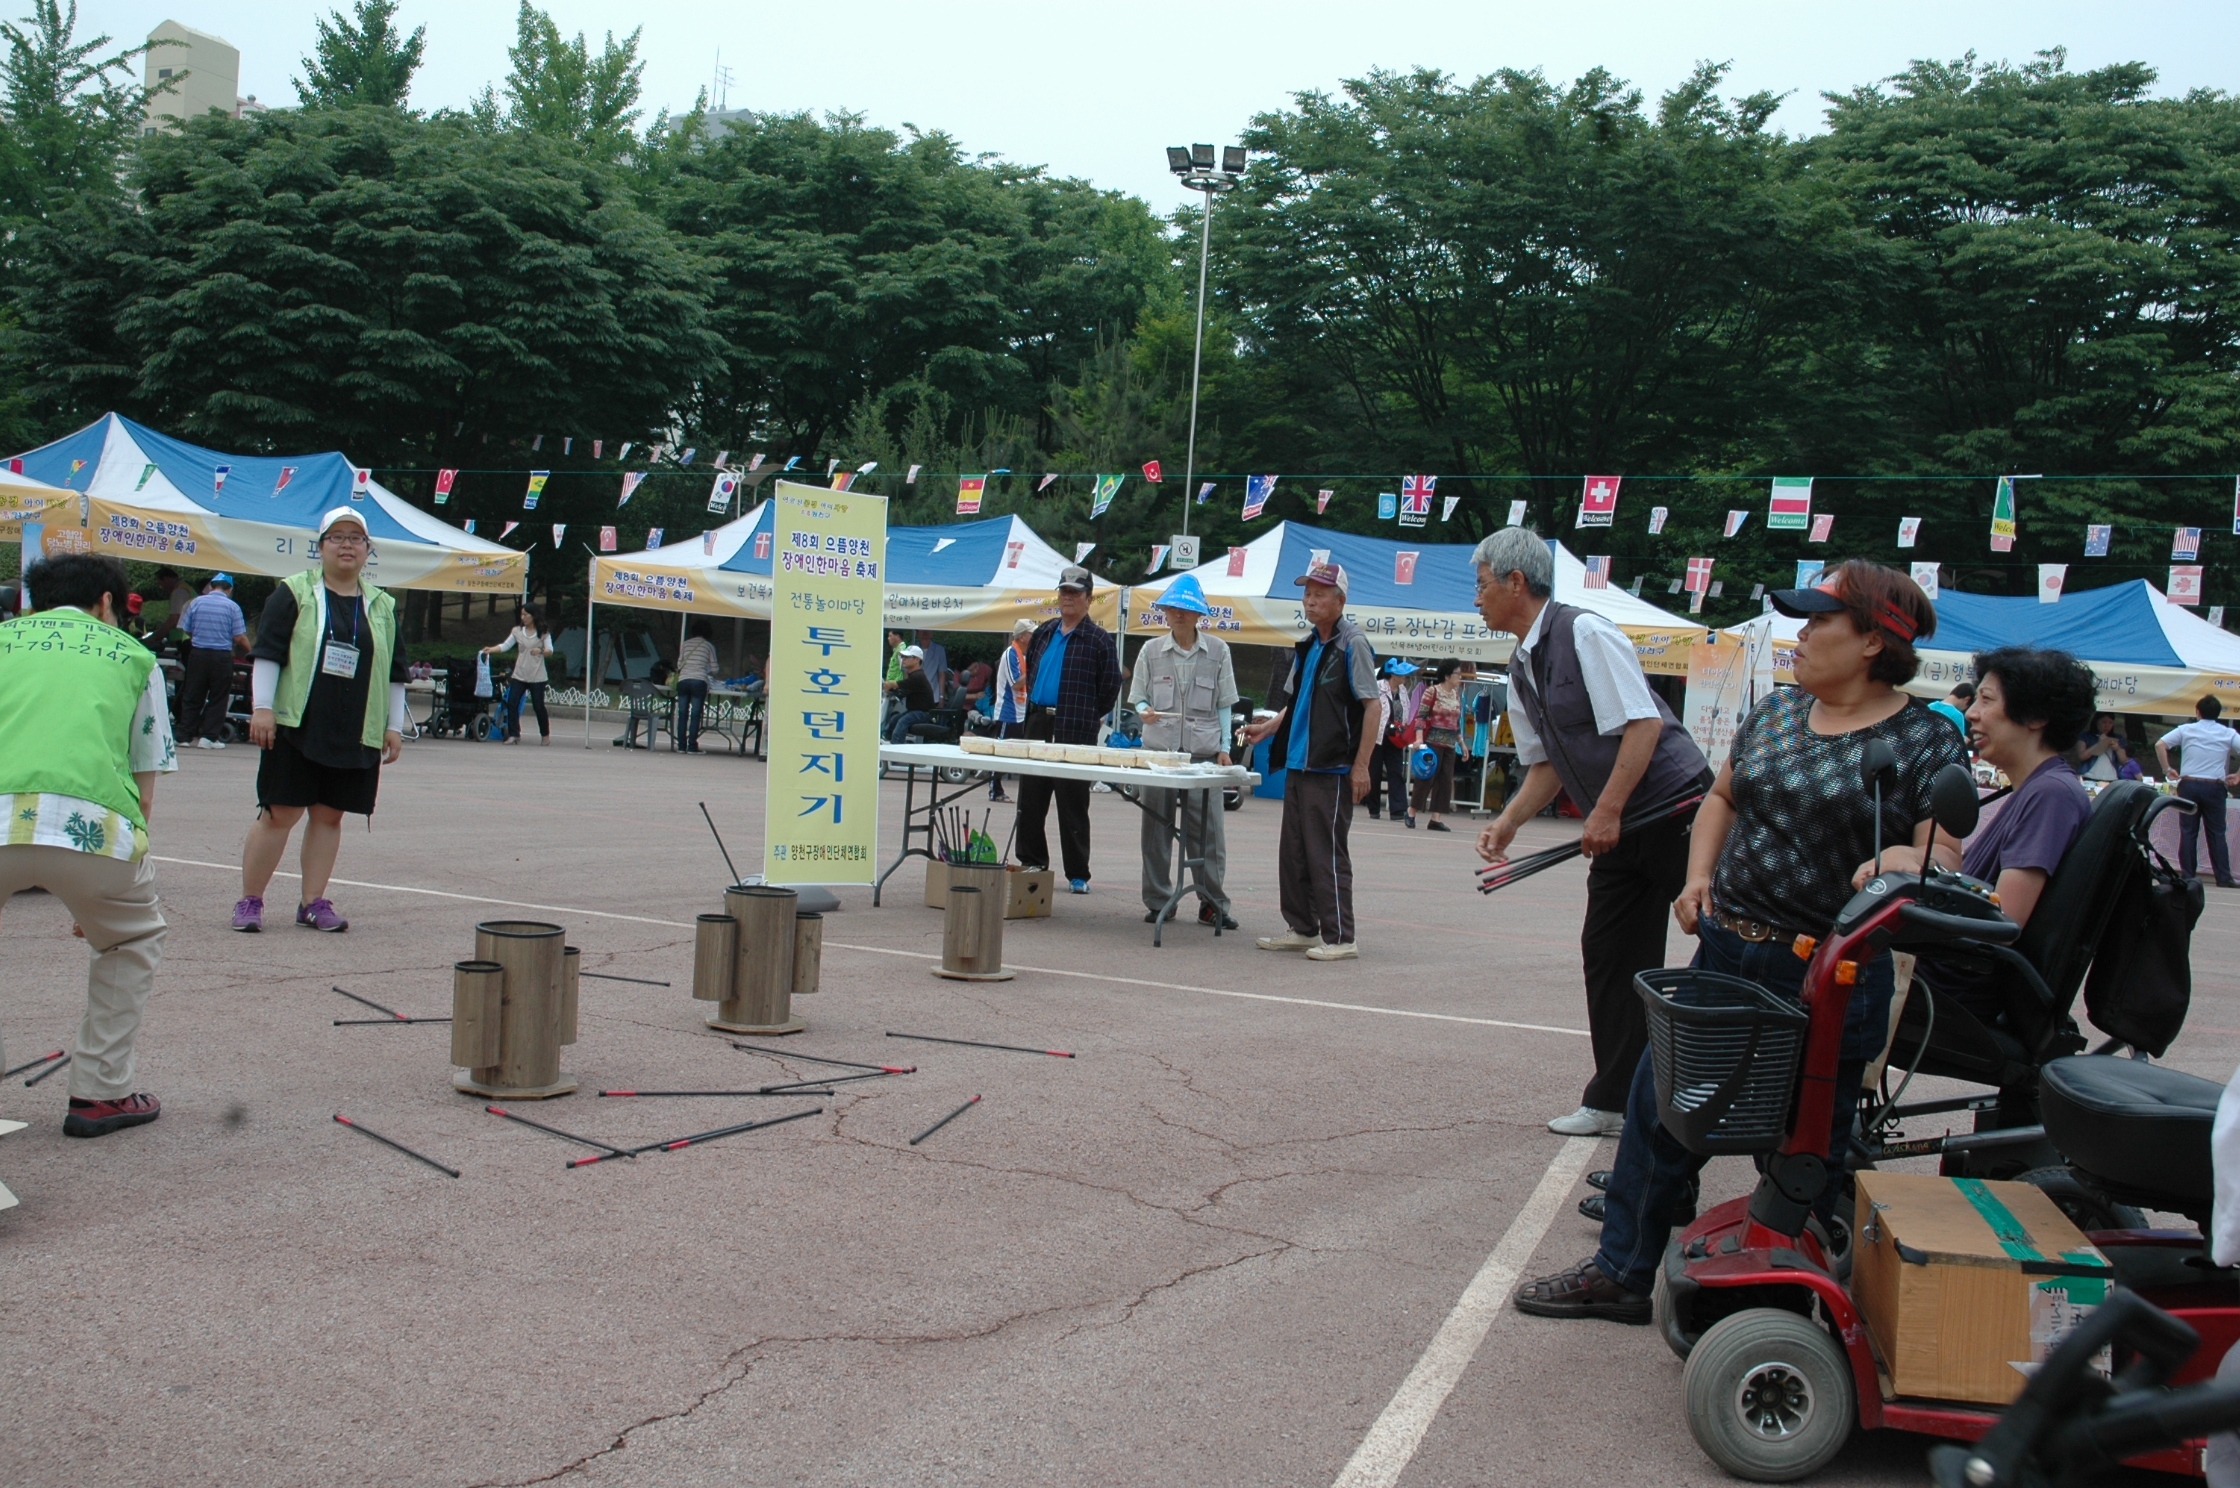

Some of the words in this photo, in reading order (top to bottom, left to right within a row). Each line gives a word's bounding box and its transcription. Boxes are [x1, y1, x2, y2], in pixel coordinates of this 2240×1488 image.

[111, 514, 139, 530] 제8회
[146, 520, 189, 538] 으뜸양천
[1771, 515, 1806, 525] Welcome
[100, 527, 169, 551] 장애인한마음
[174, 541, 196, 554] 축제
[791, 532, 819, 550] 제8회
[825, 536, 870, 557] 으뜸양천
[782, 551, 850, 577] 장애인한마음
[856, 561, 877, 579] 축제
[606, 581, 668, 599] 장애인한마음
[673, 589, 693, 601] 축제
[614, 571, 639, 582] 제8회
[645, 575, 687, 588] 으뜸양천
[790, 592, 865, 615] 전통놀이마당
[1217, 620, 1241, 631] 축제
[4, 641, 131, 665] 1-791-2147
[798, 626, 851, 824] 투호던지기
[773, 844, 787, 861] 주관
[791, 844, 867, 861] 양천구장애인단체연합회
